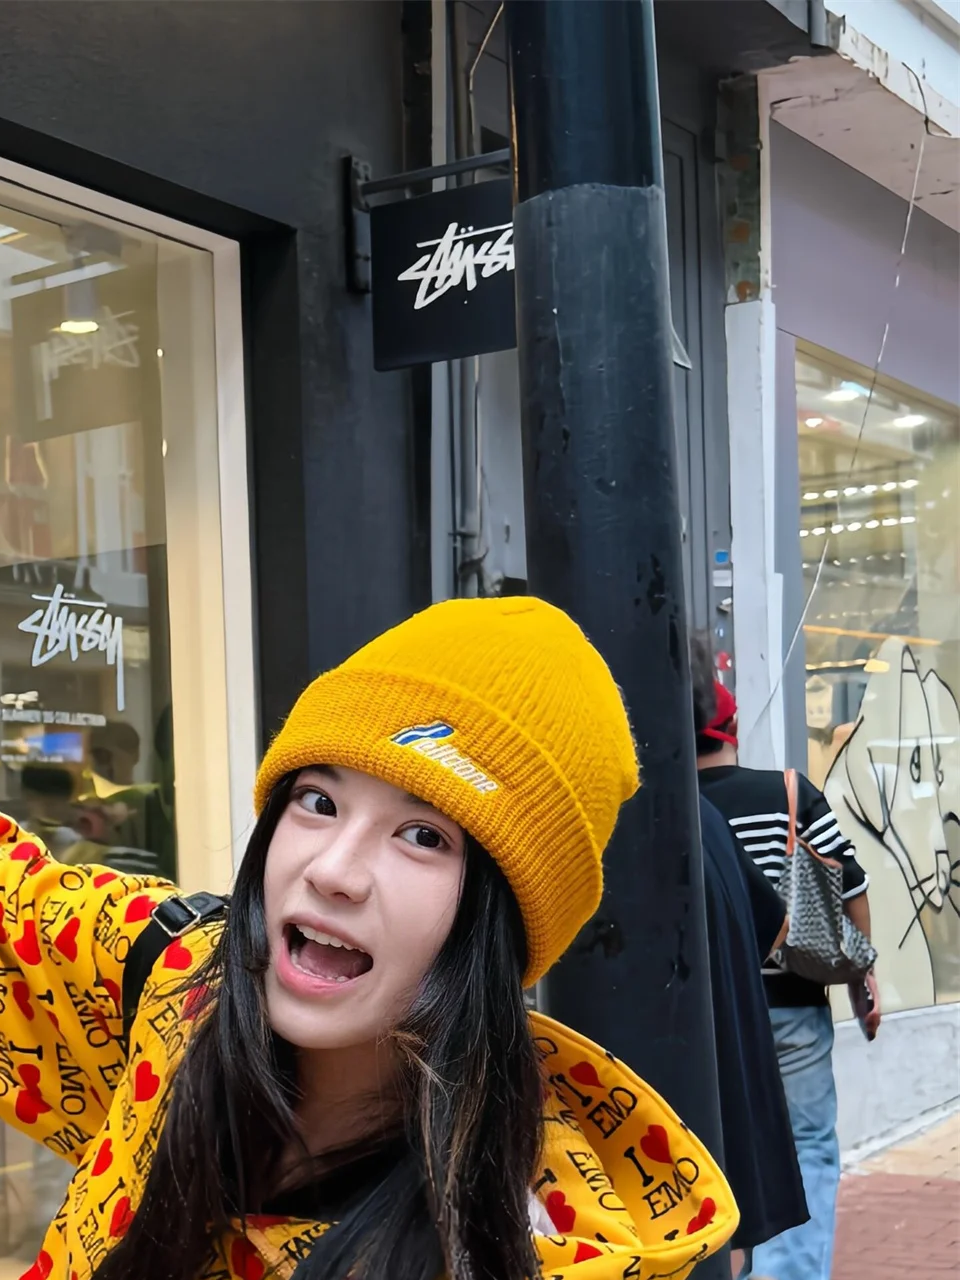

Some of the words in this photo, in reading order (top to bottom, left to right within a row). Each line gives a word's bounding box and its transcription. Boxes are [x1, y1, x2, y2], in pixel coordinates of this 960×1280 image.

[586, 1086, 638, 1139] EMO
[624, 1146, 654, 1187] I
[642, 1156, 700, 1220] EMO
[98, 1177, 126, 1214] I
